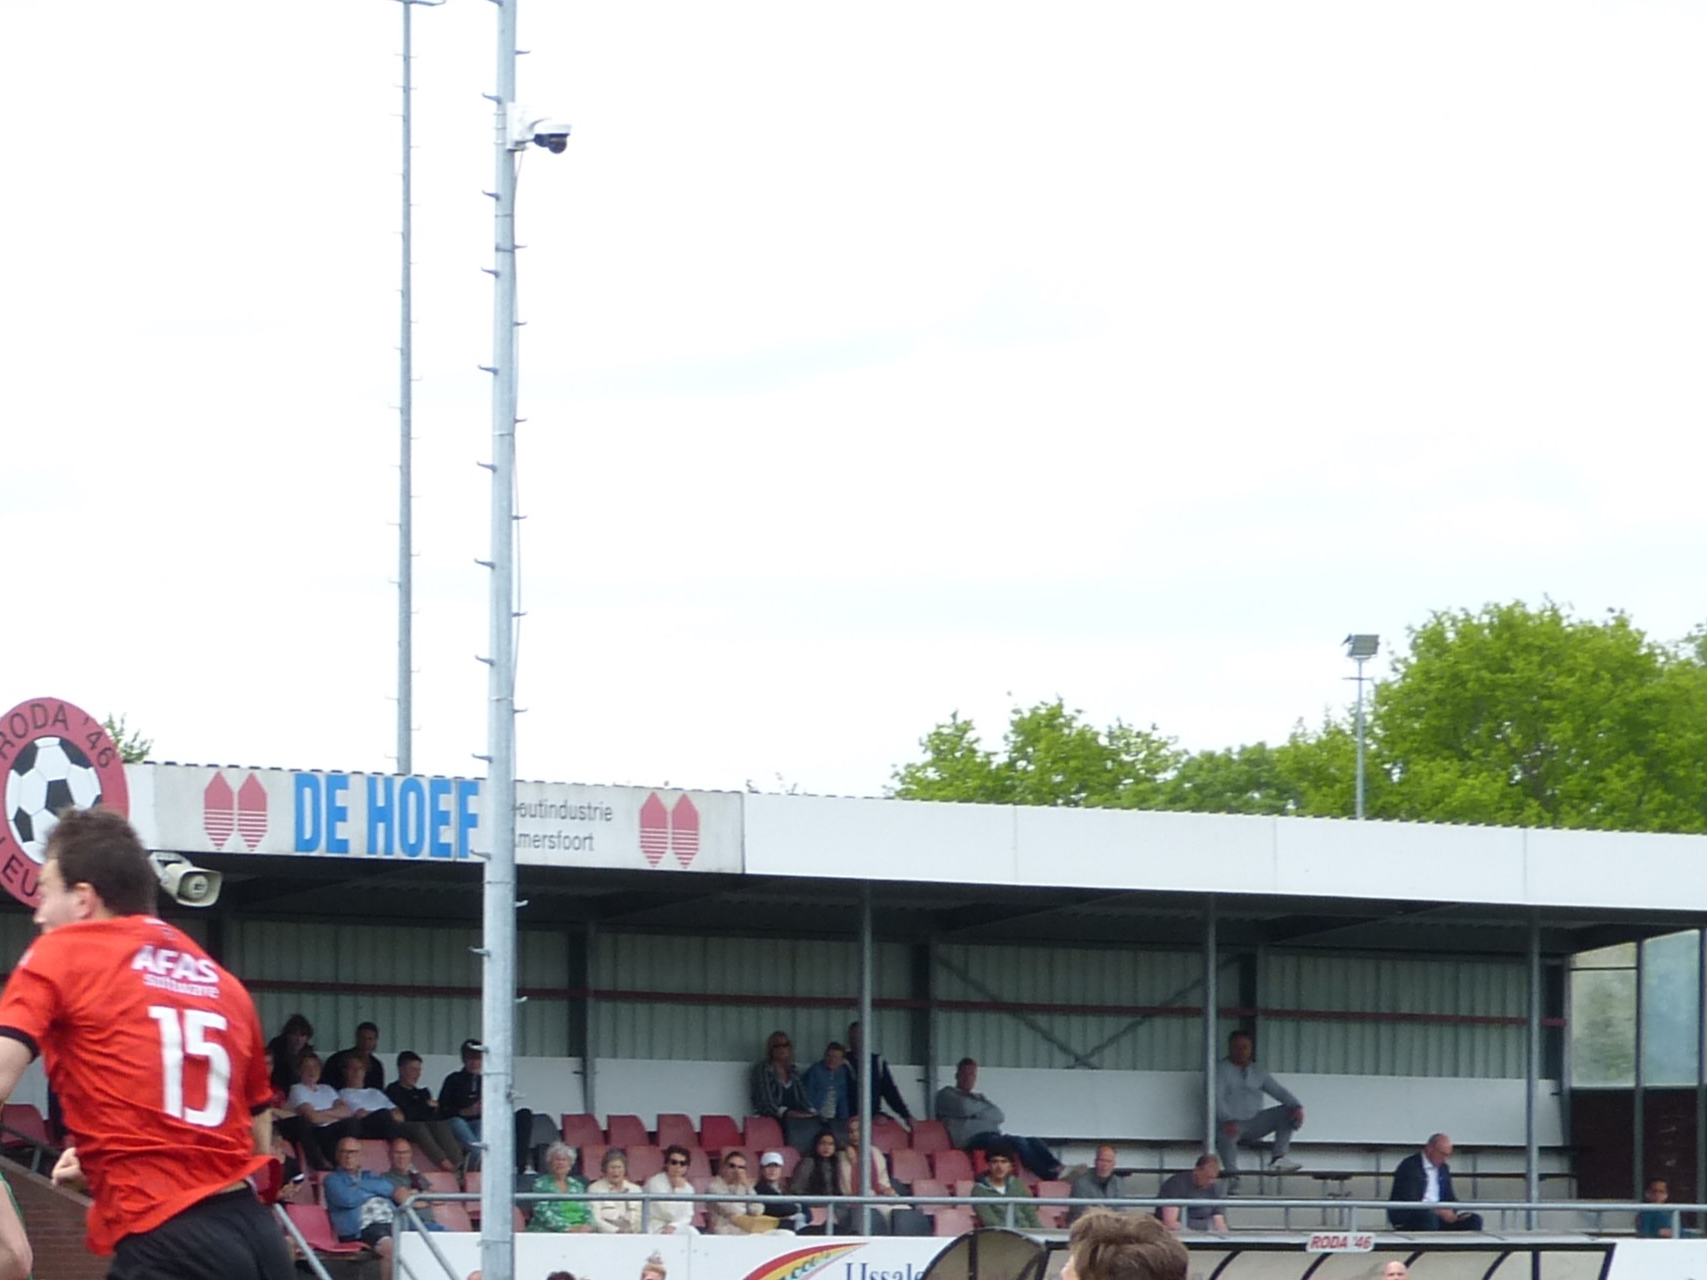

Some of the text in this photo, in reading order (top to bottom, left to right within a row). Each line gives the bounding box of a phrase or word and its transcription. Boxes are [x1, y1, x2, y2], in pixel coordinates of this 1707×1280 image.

[294, 772, 479, 858] DE HOEF
[518, 799, 614, 821] outindustrie
[514, 830, 595, 851] mersfoort
[131, 944, 220, 984] AFAS
[148, 1005, 231, 1127] 15
[1310, 1235, 1348, 1249] RODA
